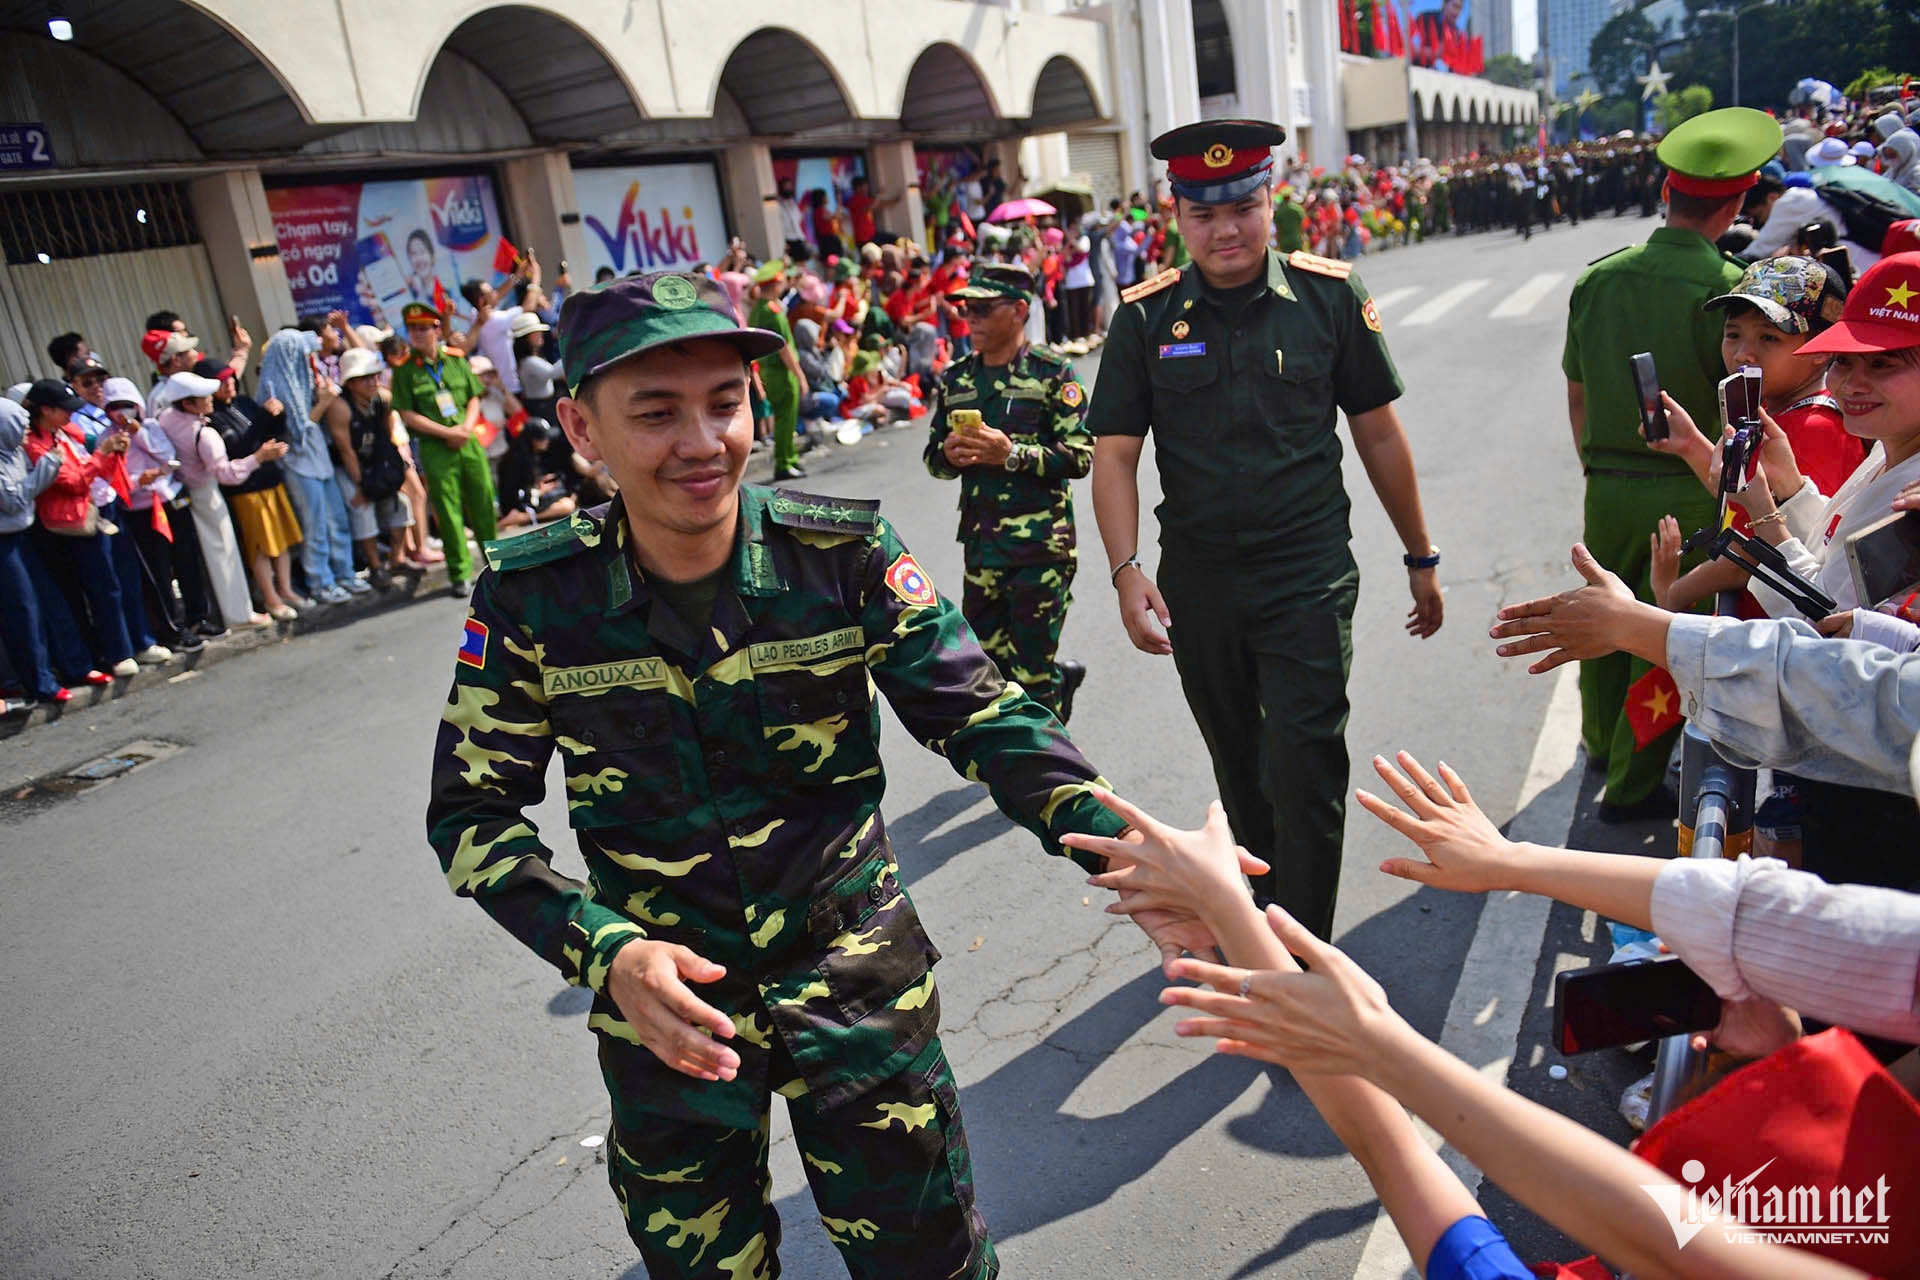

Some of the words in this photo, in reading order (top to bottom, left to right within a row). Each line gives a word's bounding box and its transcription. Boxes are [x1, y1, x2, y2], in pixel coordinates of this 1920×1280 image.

[26, 130, 50, 161] 2
[431, 190, 482, 227] Vikki
[584, 180, 700, 271] Vikki
[303, 243, 342, 261] ngay
[1869, 307, 1893, 319] VIỆT
[1893, 310, 1919, 323] NAM
[756, 646, 778, 662] LAO
[832, 630, 858, 649] ARMY
[550, 661, 658, 691] ANOUXAY
